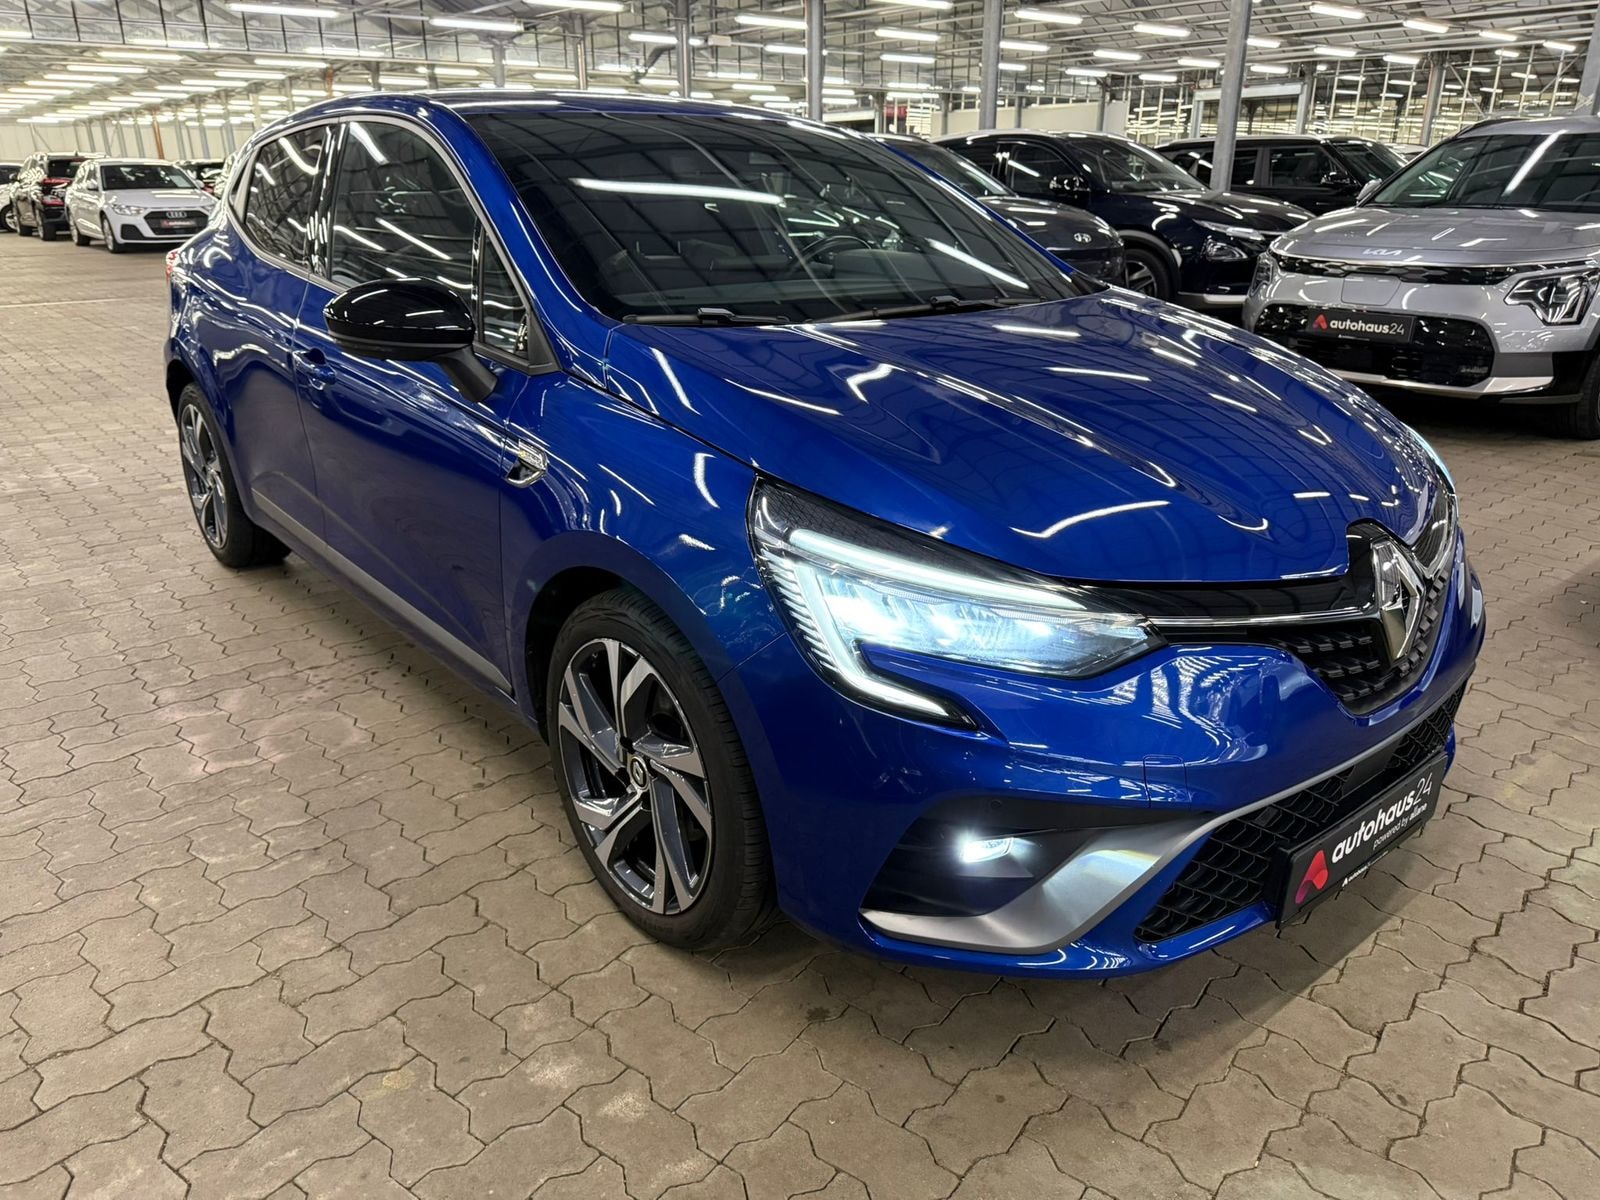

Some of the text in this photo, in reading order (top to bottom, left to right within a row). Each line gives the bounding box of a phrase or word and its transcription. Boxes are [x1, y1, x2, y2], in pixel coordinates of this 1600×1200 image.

[1330, 319, 1405, 335] autohaus24
[1332, 772, 1433, 864] autohaus24
[1373, 820, 1401, 850] powered
[1401, 816, 1409, 828] by
